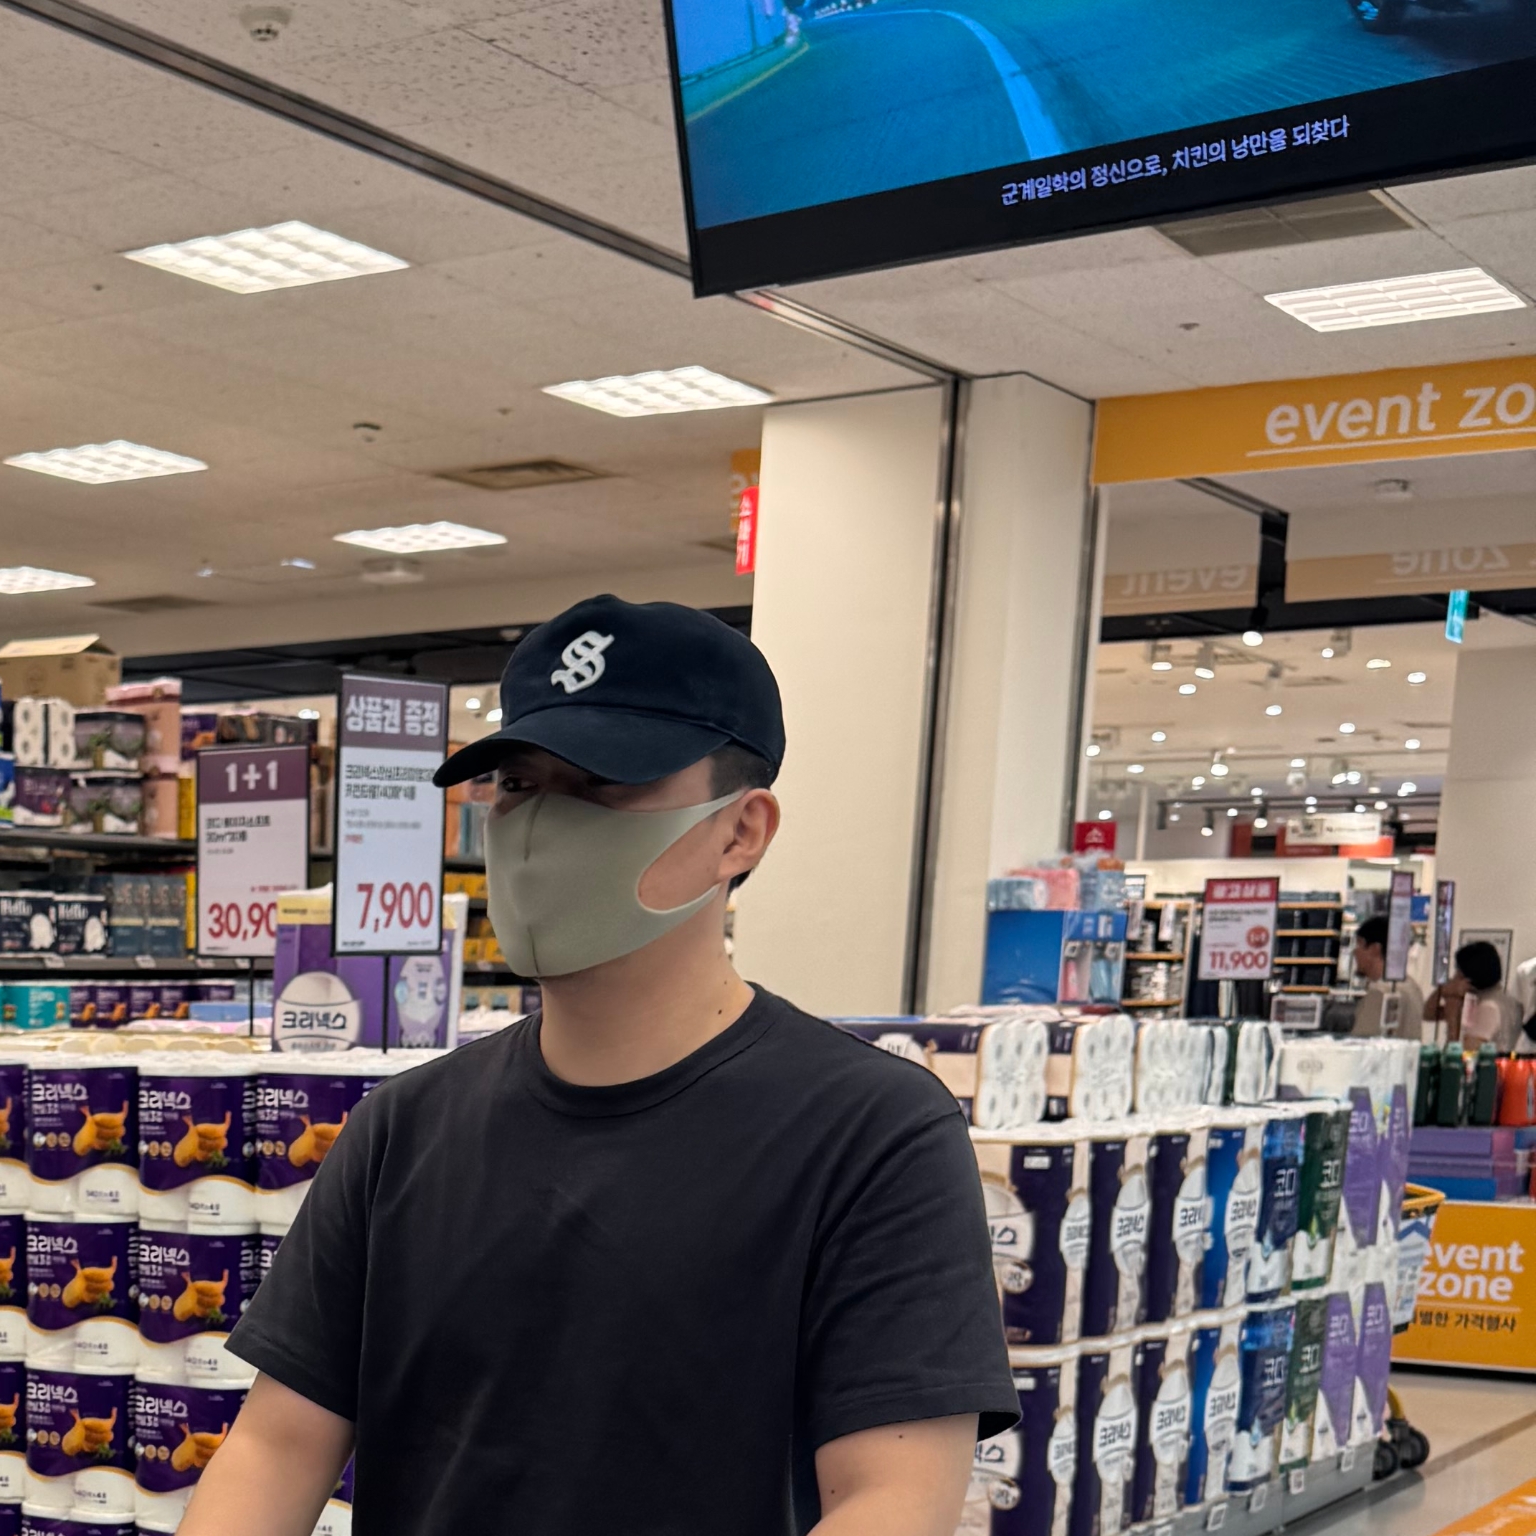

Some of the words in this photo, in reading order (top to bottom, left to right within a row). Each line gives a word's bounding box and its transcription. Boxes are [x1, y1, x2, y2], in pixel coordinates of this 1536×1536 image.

[1002, 167, 1087, 206] 군계일학의
[1090, 154, 1168, 185] 정신으로,
[1171, 139, 1227, 170] 치킨의
[1231, 127, 1287, 161] 낭만을
[1292, 114, 1350, 147] 되찾다
[1265, 382, 1442, 445] event
[345, 694, 401, 735] 상품권
[404, 698, 441, 737] 증정
[225, 760, 279, 793] 1+1
[208, 902, 278, 941] 30,90
[357, 882, 434, 933] 7,900
[1209, 951, 1269, 971] 11,900
[282, 1010, 347, 1030] 크리넥스
[31, 1082, 89, 1101] 크리넥스
[27, 1234, 78, 1255] 크리넥스
[139, 1244, 191, 1266] 크리넥스
[1426, 1240, 1525, 1273] vent
[1417, 1271, 1513, 1302] zone
[1414, 1308, 1449, 1328] 별한
[1455, 1312, 1516, 1333] 가격행사
[27, 1382, 78, 1403] 크리넥스
[135, 1394, 188, 1418] 크리넥스
